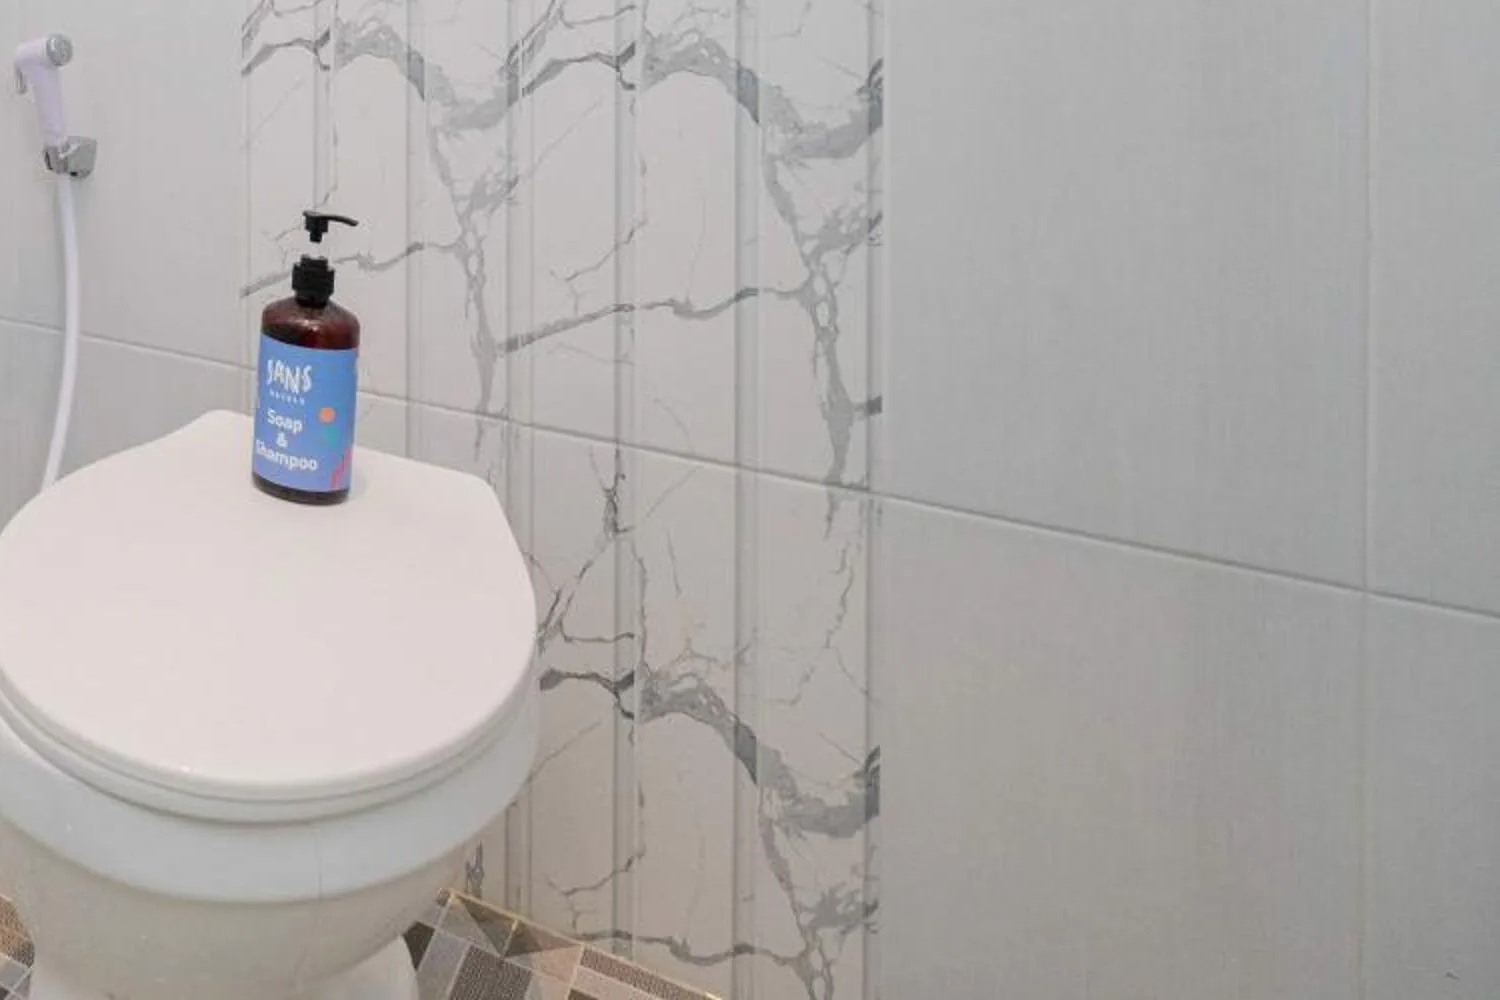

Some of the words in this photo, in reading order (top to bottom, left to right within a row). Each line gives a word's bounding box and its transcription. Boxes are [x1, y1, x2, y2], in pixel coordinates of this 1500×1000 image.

[267, 408, 303, 434] Soap
[276, 432, 288, 448] &
[256, 439, 318, 471] Shampoo
